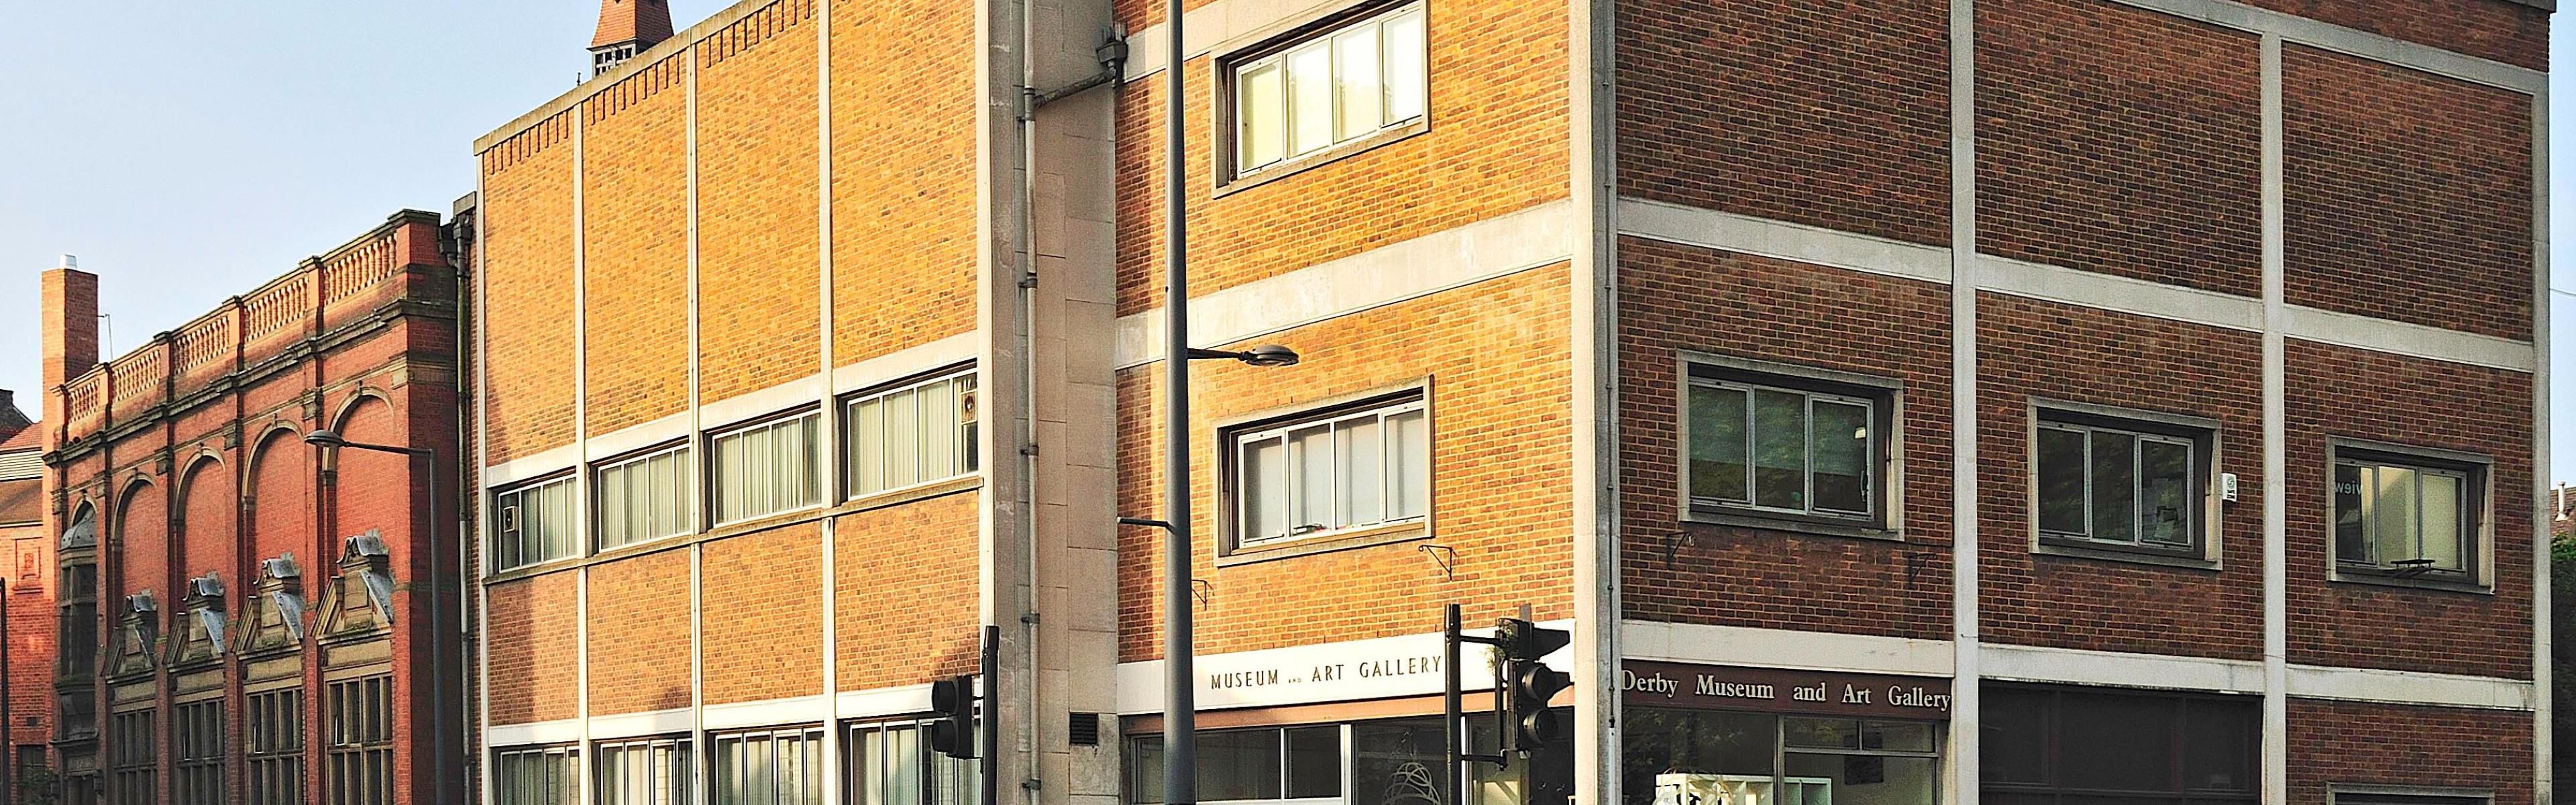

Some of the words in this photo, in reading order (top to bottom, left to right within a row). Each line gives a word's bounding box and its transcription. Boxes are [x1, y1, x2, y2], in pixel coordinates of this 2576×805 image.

[1211, 669, 1278, 690] MUSEUM
[1311, 664, 1344, 682] ART
[1359, 655, 1441, 678] GALLERY
[1621, 669, 1678, 698] Derby
[1695, 674, 1775, 699] Museum
[1793, 682, 1827, 702] and
[1841, 683, 1872, 704] Art
[1888, 685, 1951, 712] Gallery
